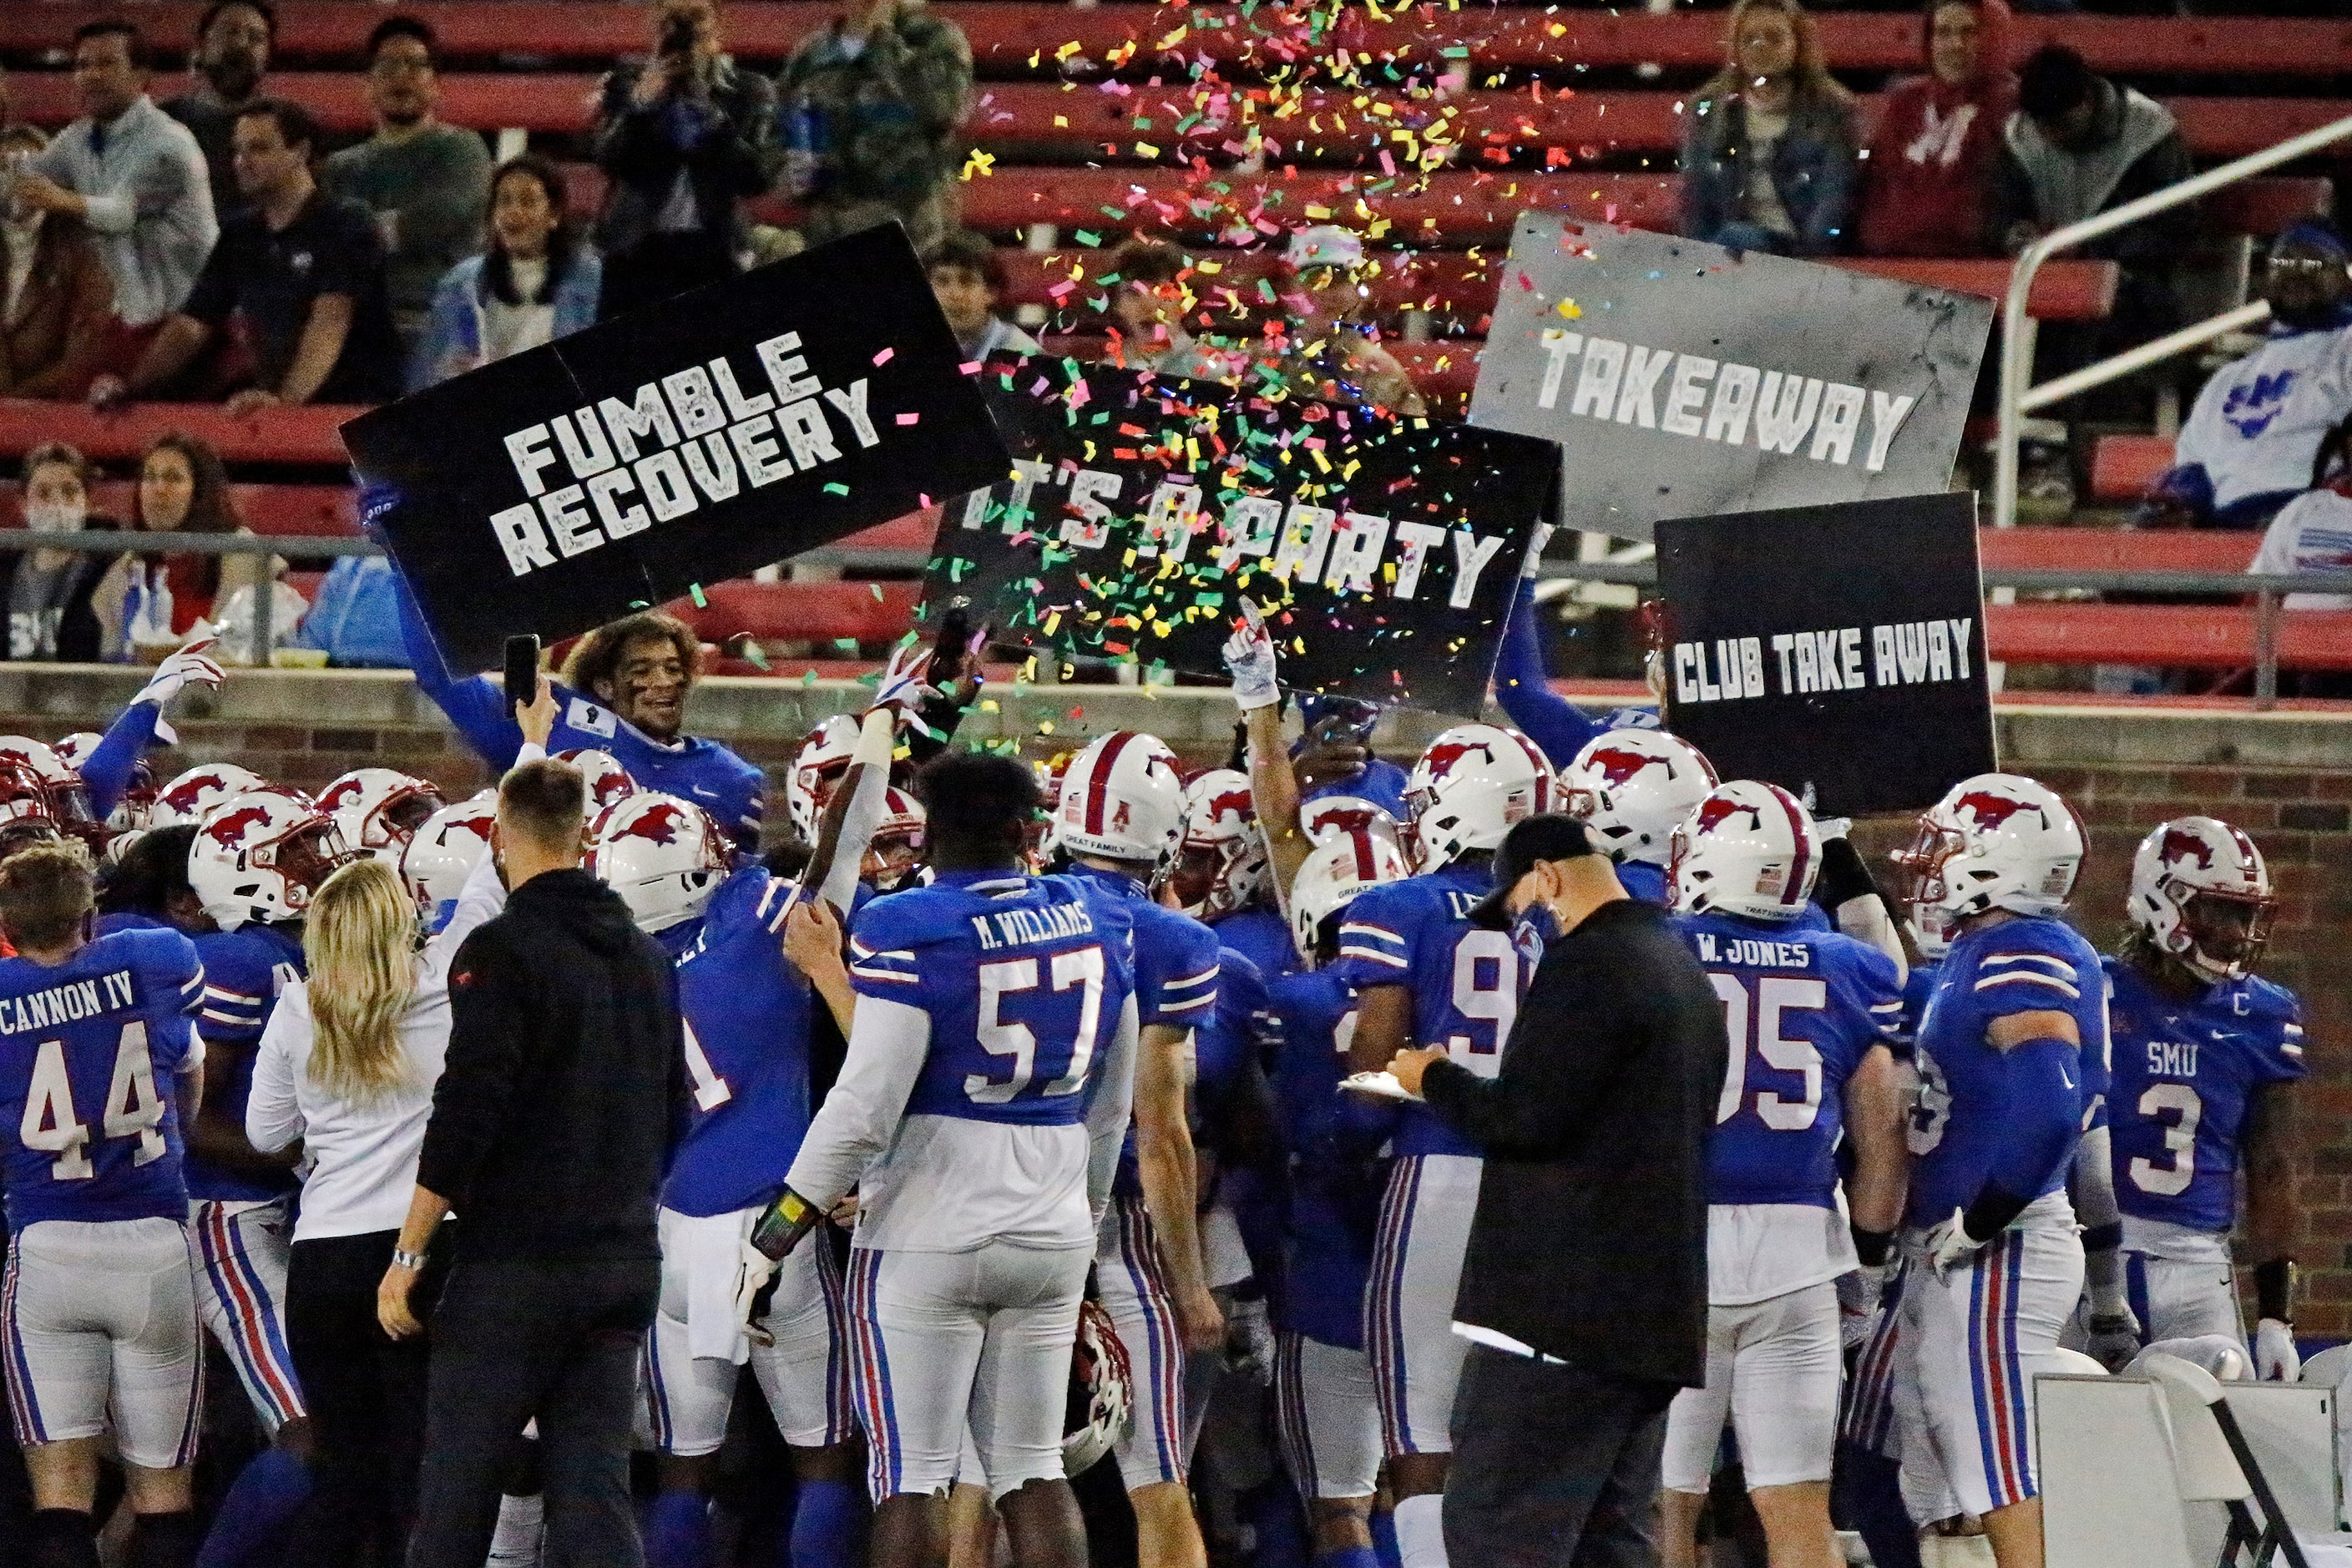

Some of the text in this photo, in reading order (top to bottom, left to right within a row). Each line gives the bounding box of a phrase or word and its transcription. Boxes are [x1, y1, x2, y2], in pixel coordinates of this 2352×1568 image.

[503, 331, 822, 497] FUMBLE
[1539, 328, 1914, 472] TAKEAWAY
[489, 377, 880, 576] RECOVERY
[1138, 482, 1202, 561] A
[1216, 495, 1505, 609] PARTY
[1675, 618, 1971, 703] CLUB TAKE AWAY
[1065, 834, 1126, 853] GREAT FAMILY
[1338, 884, 1368, 898] GREAT
[1697, 933, 1810, 969] W. JONES
[0, 970, 134, 1035] CANNON IV
[964, 946, 1104, 1103] 57
[2233, 993, 2250, 1016] C
[20, 1020, 167, 1180] 44
[2147, 1041, 2198, 1077] SMU
[2129, 1083, 2202, 1196] 3
